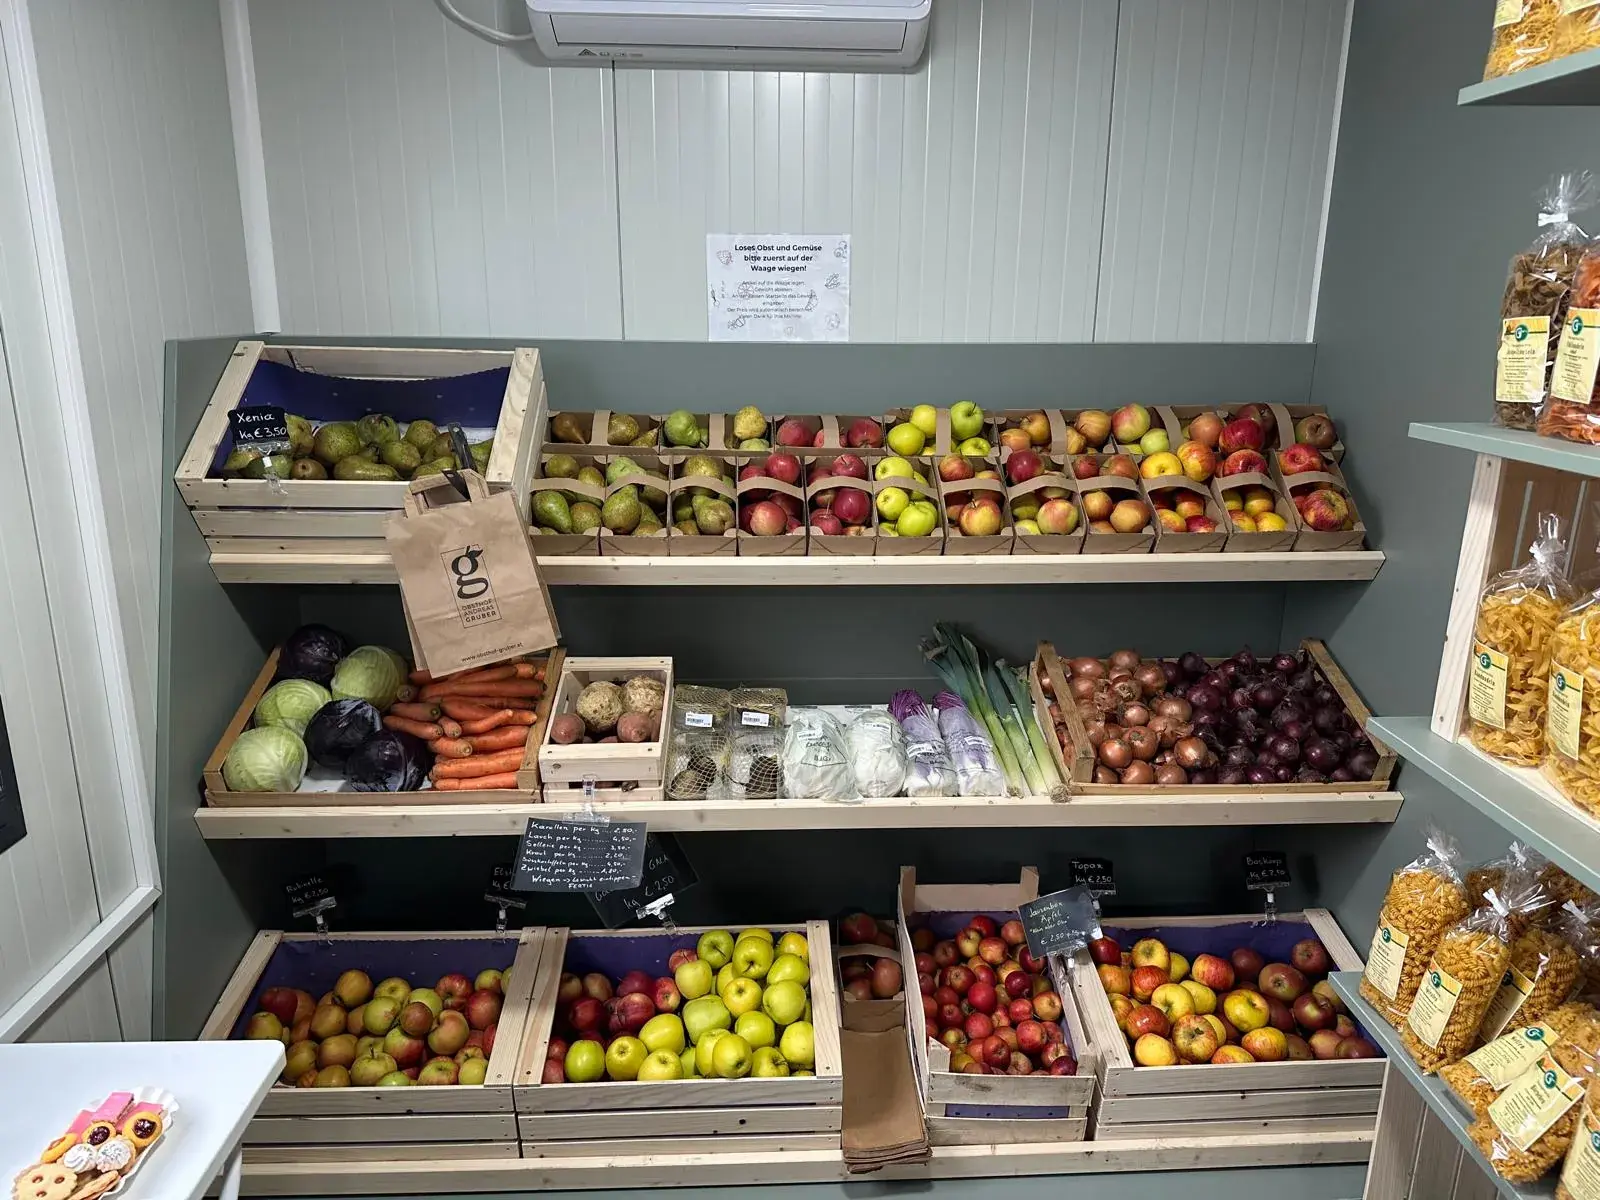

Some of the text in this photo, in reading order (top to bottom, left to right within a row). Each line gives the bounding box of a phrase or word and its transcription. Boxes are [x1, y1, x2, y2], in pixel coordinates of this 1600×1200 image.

[236, 412, 276, 423] Xenia
[461, 598, 493, 611] OBSTHOF
[464, 604, 495, 617] ANDREAS
[465, 610, 497, 623] GRUBER
[528, 831, 553, 840] Lauch
[531, 874, 561, 886] Wiegen
